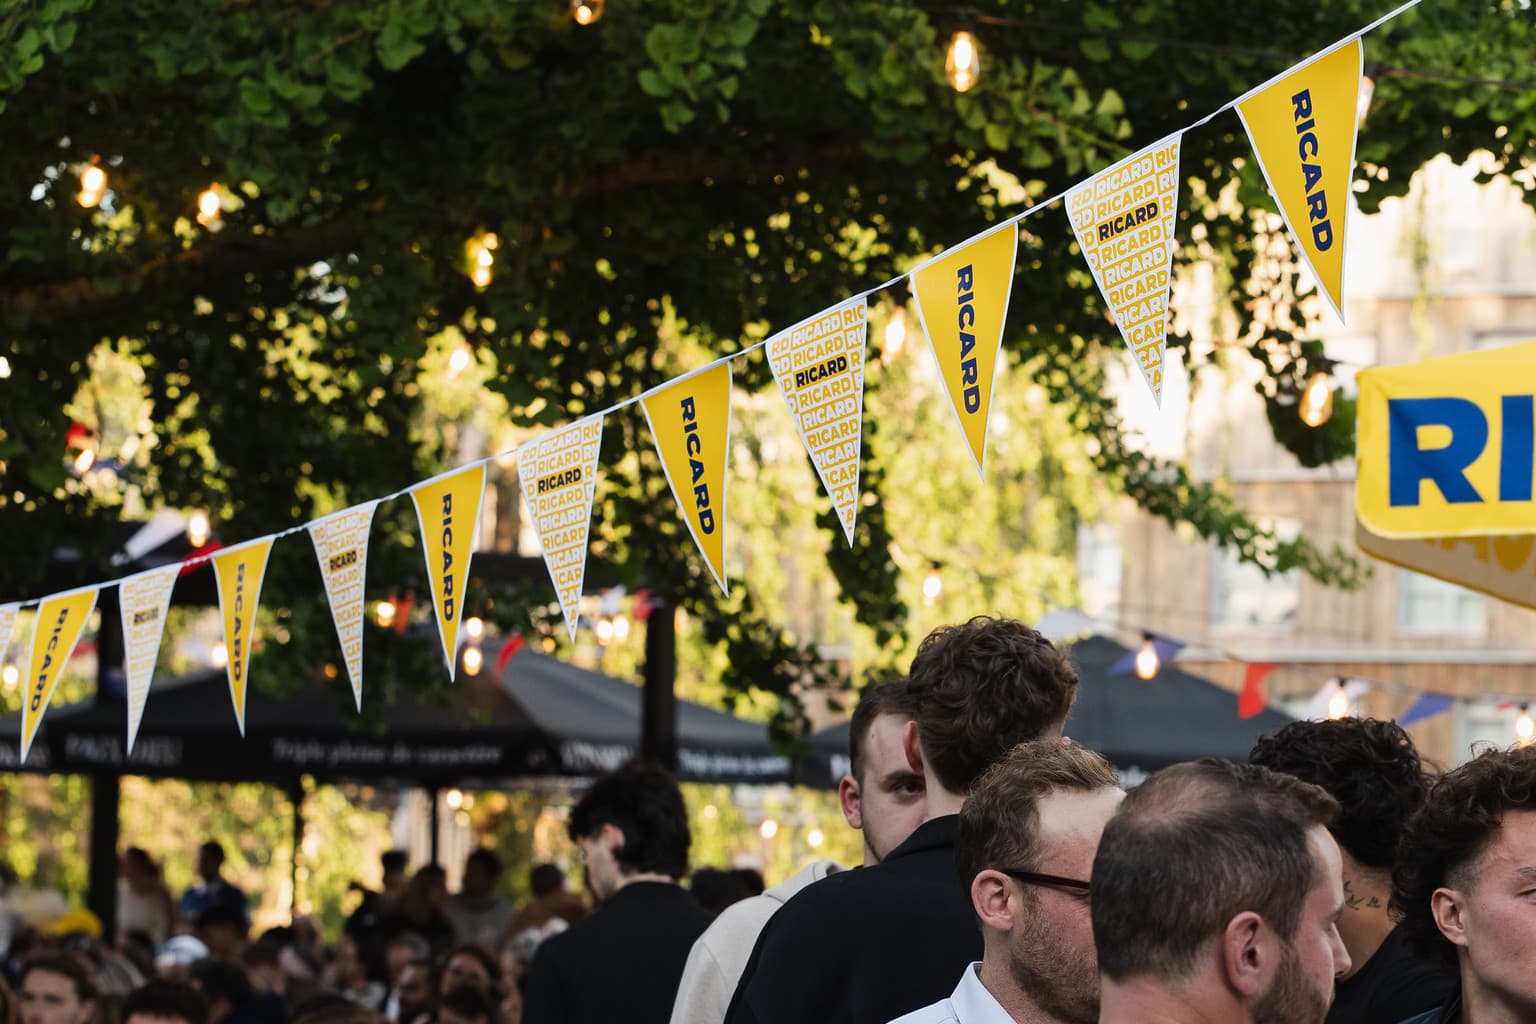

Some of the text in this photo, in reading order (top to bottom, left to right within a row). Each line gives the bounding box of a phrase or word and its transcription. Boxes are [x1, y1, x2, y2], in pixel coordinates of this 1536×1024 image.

[1097, 156, 1153, 195] RICARD
[1291, 88, 1334, 252] RICARD
[1098, 182, 1155, 218] RICARD
[1100, 202, 1158, 240] RICARD
[1101, 225, 1161, 263] RICARD
[1106, 246, 1165, 285] RICARD
[1110, 270, 1168, 306] RICARD
[792, 312, 841, 347] RICARD
[957, 264, 980, 414] RICARD
[793, 335, 843, 367] RICARD
[795, 356, 847, 387] RICARD
[799, 377, 851, 408] RICARD
[802, 397, 856, 429] RICARD
[808, 419, 859, 449] RICARD
[538, 450, 580, 472] RICARD
[681, 396, 715, 535] RICARD
[538, 469, 581, 493] RICARD
[539, 488, 583, 512] RICARD
[540, 506, 585, 532] RICARD
[543, 527, 585, 550] RICARD
[330, 550, 357, 572] RICARD
[442, 493, 454, 621] RICARD
[30, 608, 69, 712] RICARD
